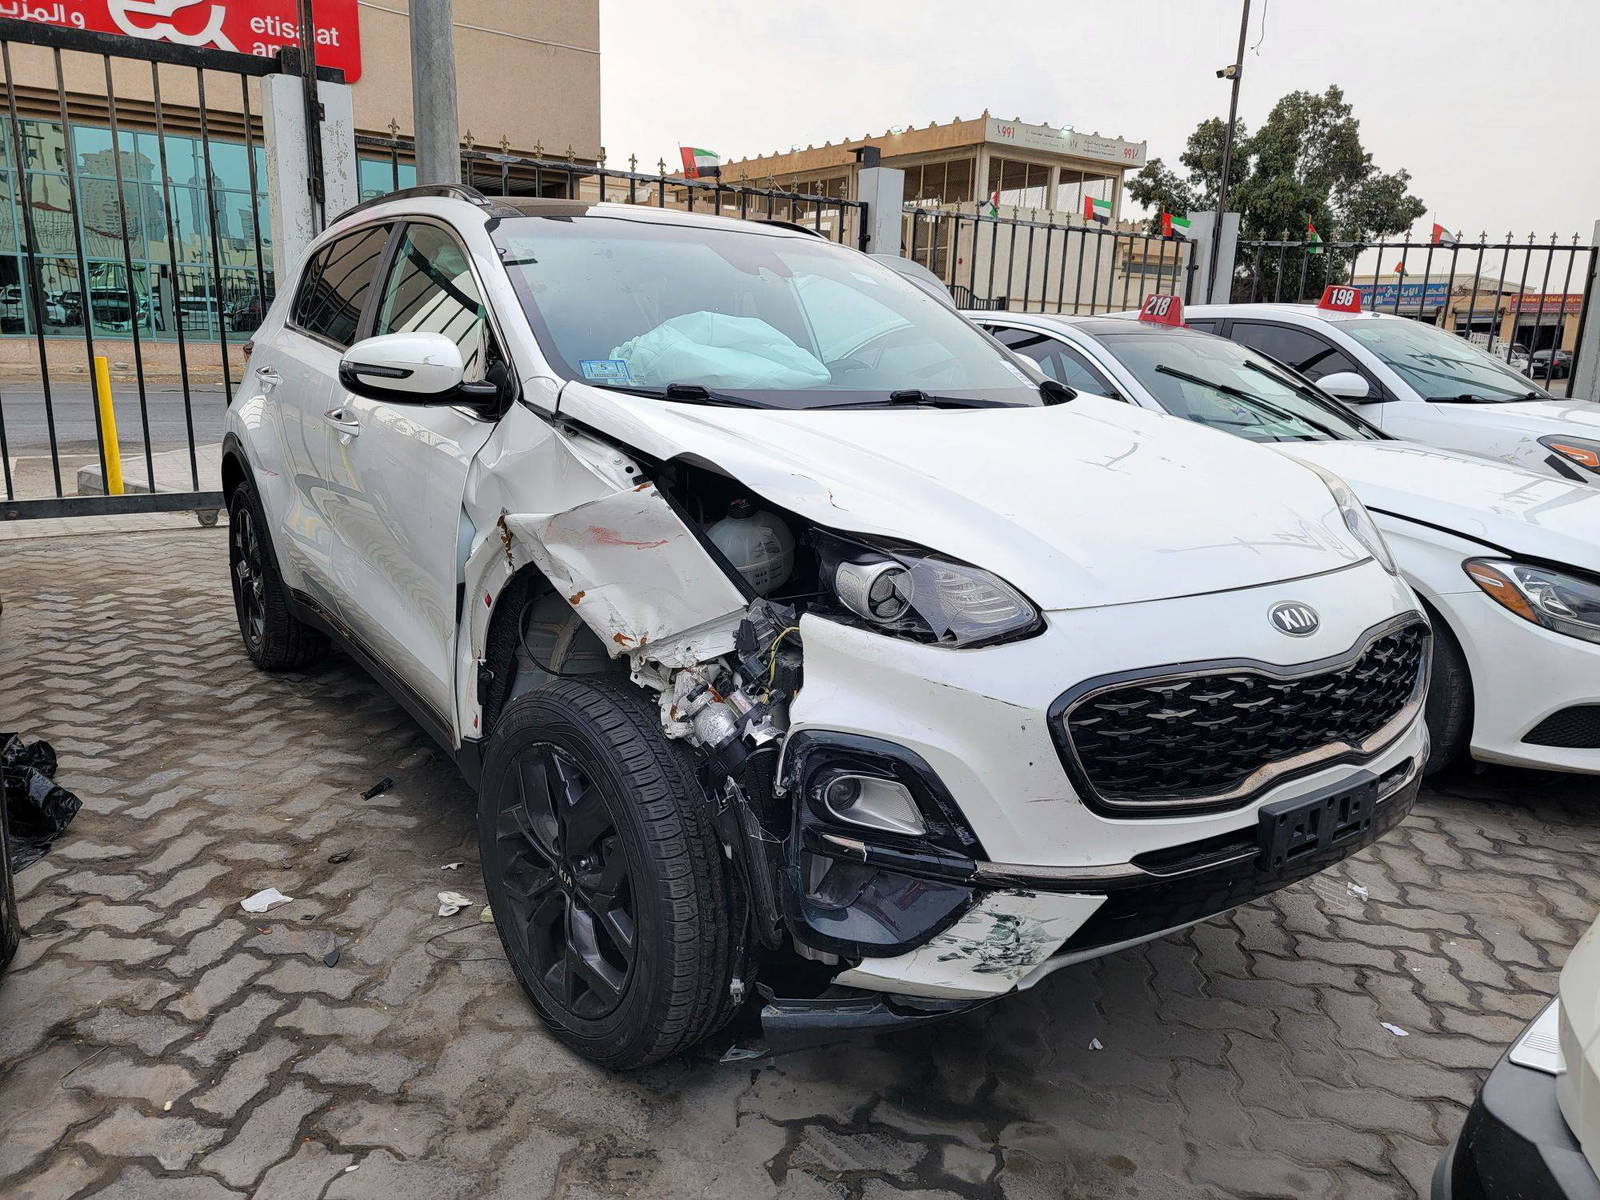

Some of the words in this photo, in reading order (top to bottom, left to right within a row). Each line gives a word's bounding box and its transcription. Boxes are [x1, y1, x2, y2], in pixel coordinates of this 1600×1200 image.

[1144, 295, 1171, 317] 218
[1331, 288, 1355, 307] 198
[1276, 606, 1318, 630] KIA
